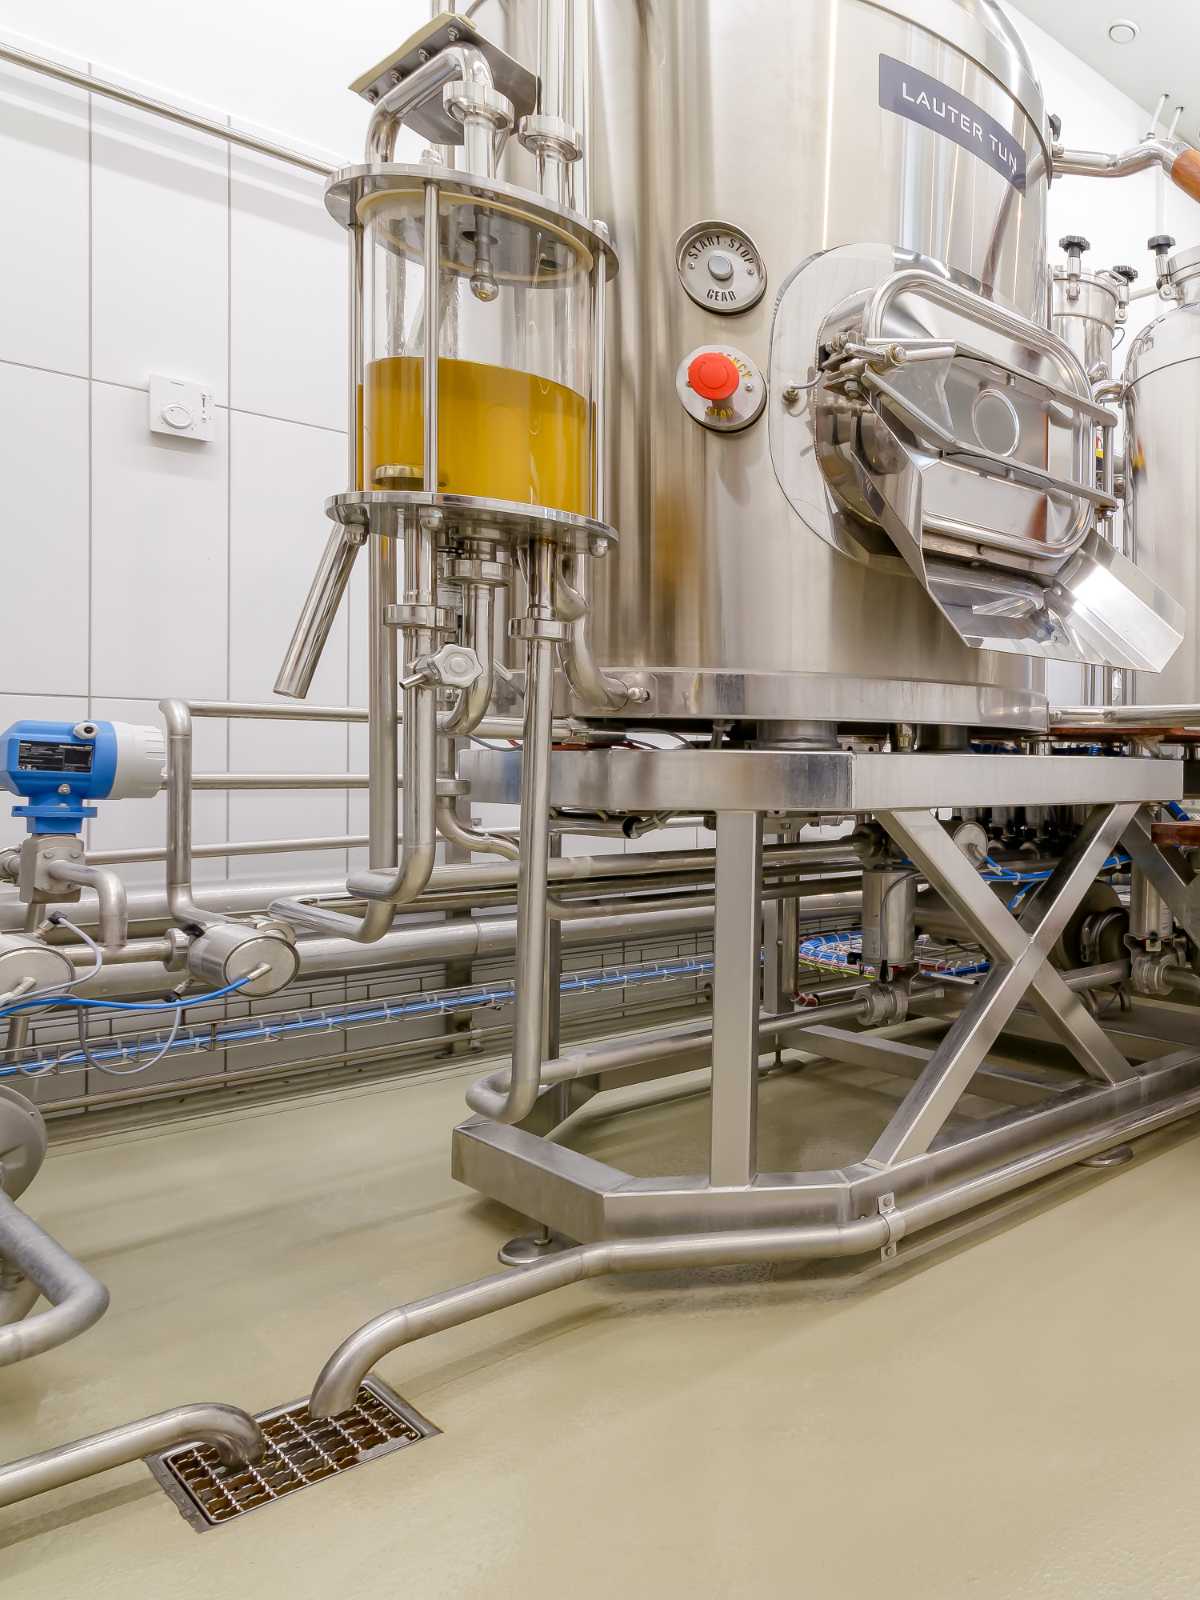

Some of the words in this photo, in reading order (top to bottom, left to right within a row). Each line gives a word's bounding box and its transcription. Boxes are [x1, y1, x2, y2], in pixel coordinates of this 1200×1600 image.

[901, 82, 984, 142] LAUTER
[989, 134, 1017, 175] TUN
[688, 235, 721, 260] START
[728, 238, 754, 264] STOP
[706, 288, 737, 302] GEAR
